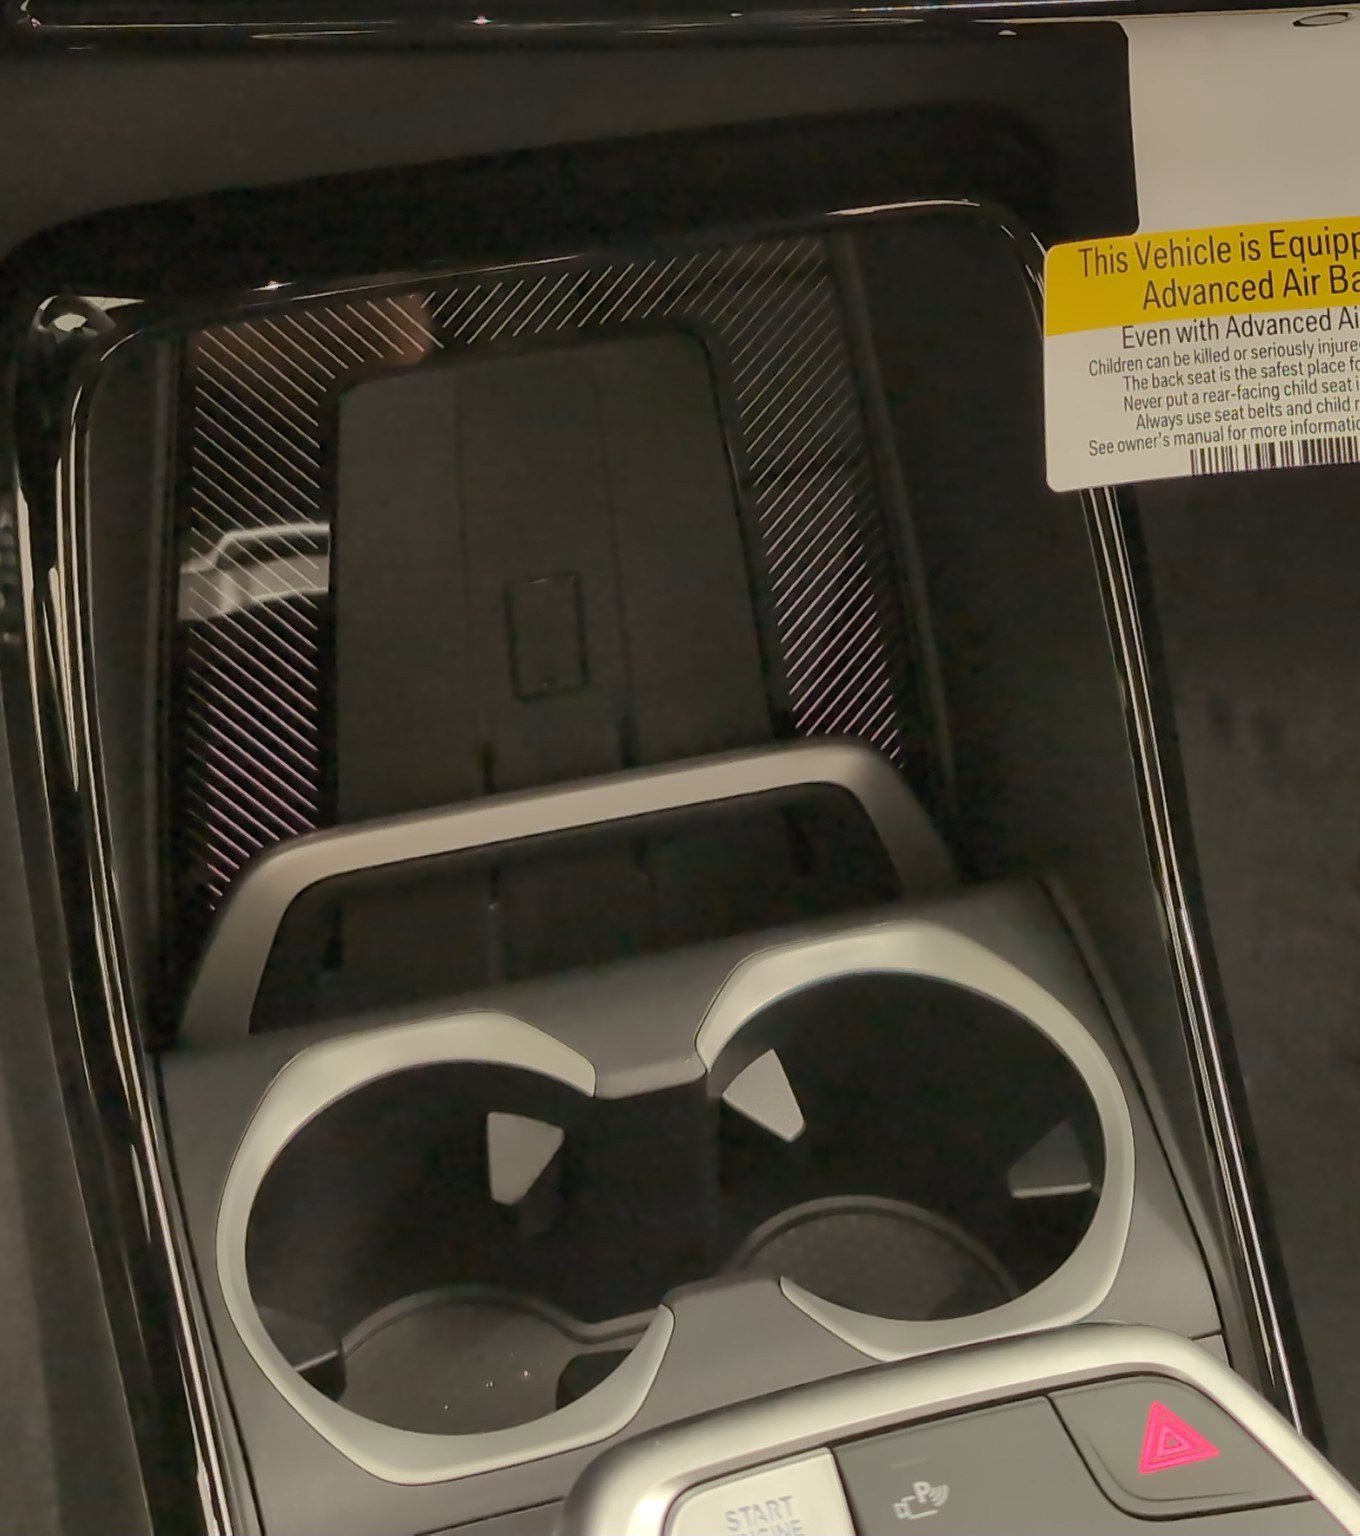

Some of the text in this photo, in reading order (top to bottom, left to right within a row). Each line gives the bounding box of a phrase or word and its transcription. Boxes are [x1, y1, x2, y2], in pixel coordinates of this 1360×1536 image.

[1078, 245, 1128, 277] This
[1135, 235, 1231, 270] Vehicle
[1239, 232, 1261, 261] is
[1143, 270, 1274, 310] Advanced
[1283, 267, 1321, 297] Air
[1122, 325, 1170, 349] Even
[1176, 318, 1219, 343] with
[1226, 308, 1331, 339] Advanced
[1089, 356, 1142, 376] Children
[1146, 356, 1170, 369] can
[1173, 351, 1190, 366] be
[1194, 346, 1229, 364] killed
[1234, 348, 1247, 361] or
[1251, 338, 1314, 358] seriously
[1122, 375, 1148, 391] The
[1151, 372, 1184, 388] back
[1187, 368, 1216, 385] seat
[1219, 366, 1231, 382] is
[1235, 364, 1257, 380] the
[1261, 360, 1304, 378] safest
[1307, 358, 1346, 378] place
[1124, 395, 1163, 412] Never
[1166, 391, 1189, 410] put
[1191, 392, 1200, 405] a
[1203, 382, 1280, 404] rear-facing
[1283, 379, 1317, 396] child
[1321, 377, 1352, 393] seat
[1136, 413, 1183, 430] Always
[1187, 412, 1211, 425] use
[1214, 407, 1244, 423] seat
[1247, 402, 1282, 419] belts
[1286, 399, 1312, 416] and
[1316, 396, 1351, 413] child
[1089, 440, 1114, 456] See
[1117, 431, 1170, 453] owner's
[1174, 425, 1223, 446] manual
[1228, 425, 1247, 441] for
[1250, 424, 1287, 438] more
[725, 1495, 793, 1532] START
